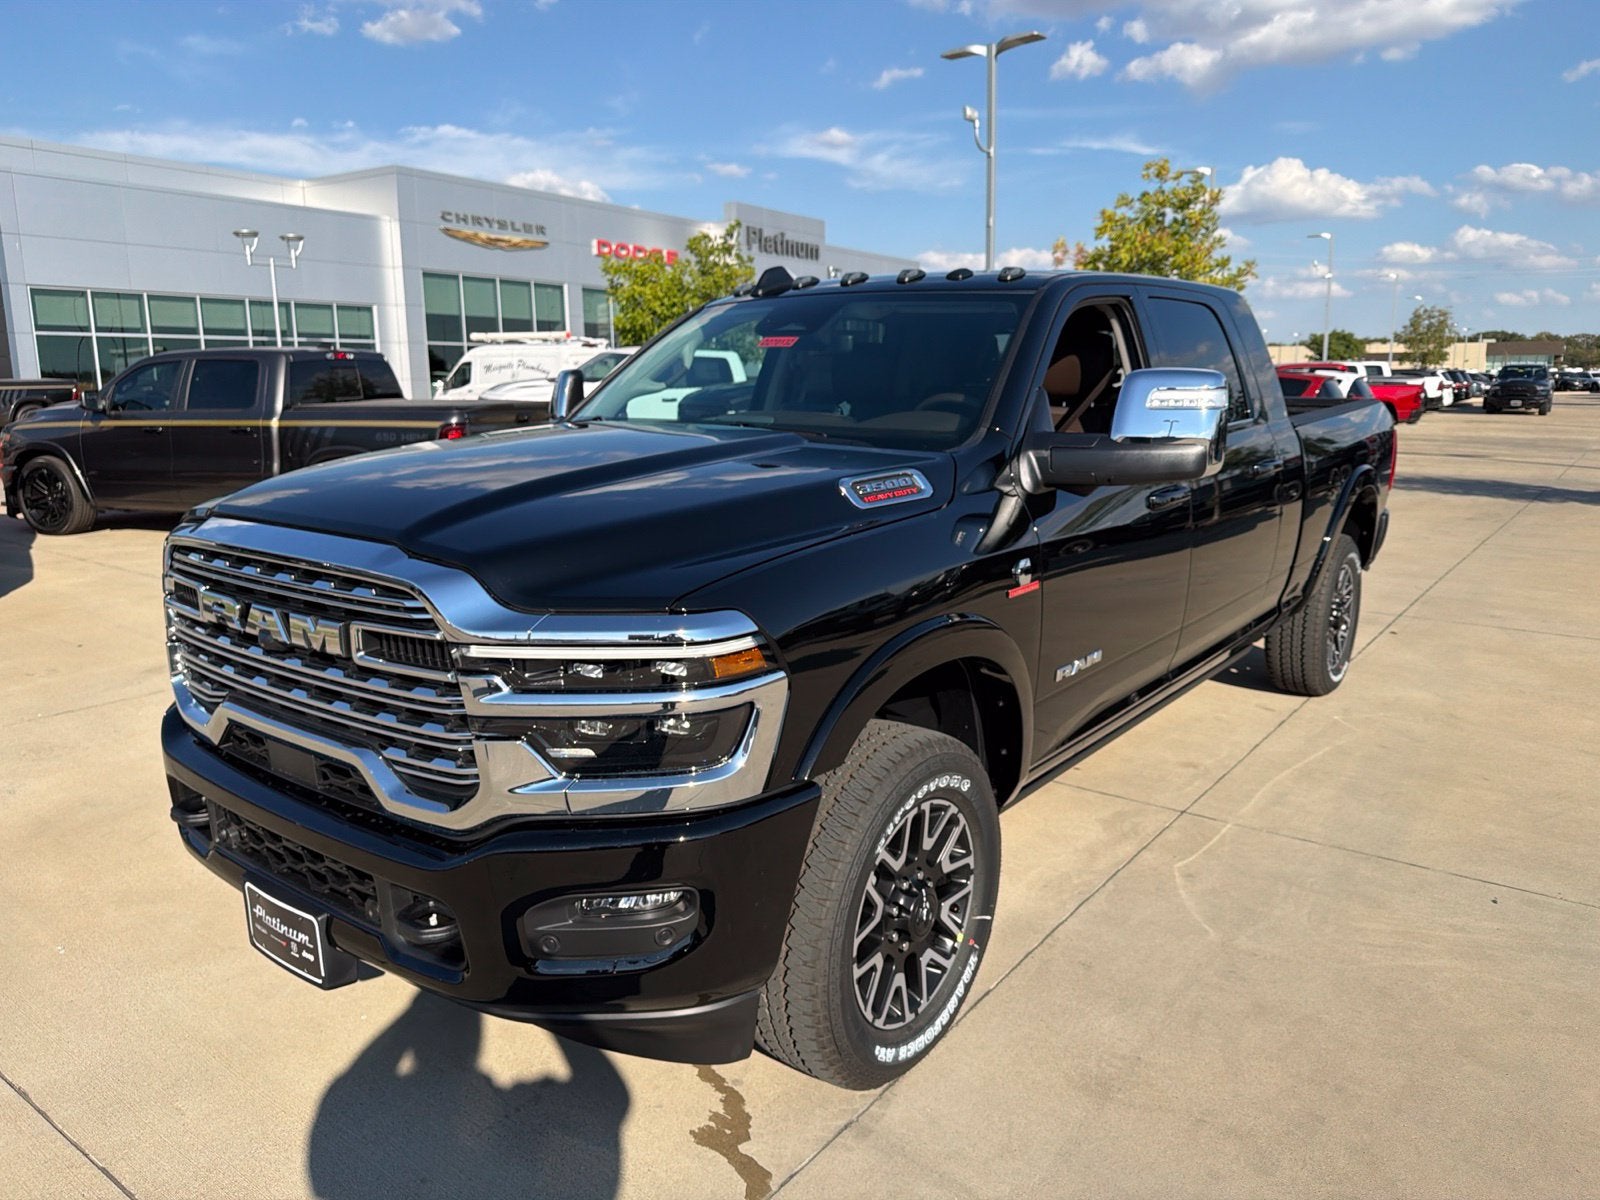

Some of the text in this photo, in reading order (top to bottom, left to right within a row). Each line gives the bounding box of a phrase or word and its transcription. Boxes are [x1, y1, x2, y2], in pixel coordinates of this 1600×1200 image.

[440, 210, 547, 236] CHRYSLER
[746, 225, 820, 261] Platinum
[863, 487, 918, 503] HEAVY DUTY
[200, 588, 349, 658] RAM
[1055, 650, 1103, 683] RAM
[253, 904, 314, 949] Platinum
